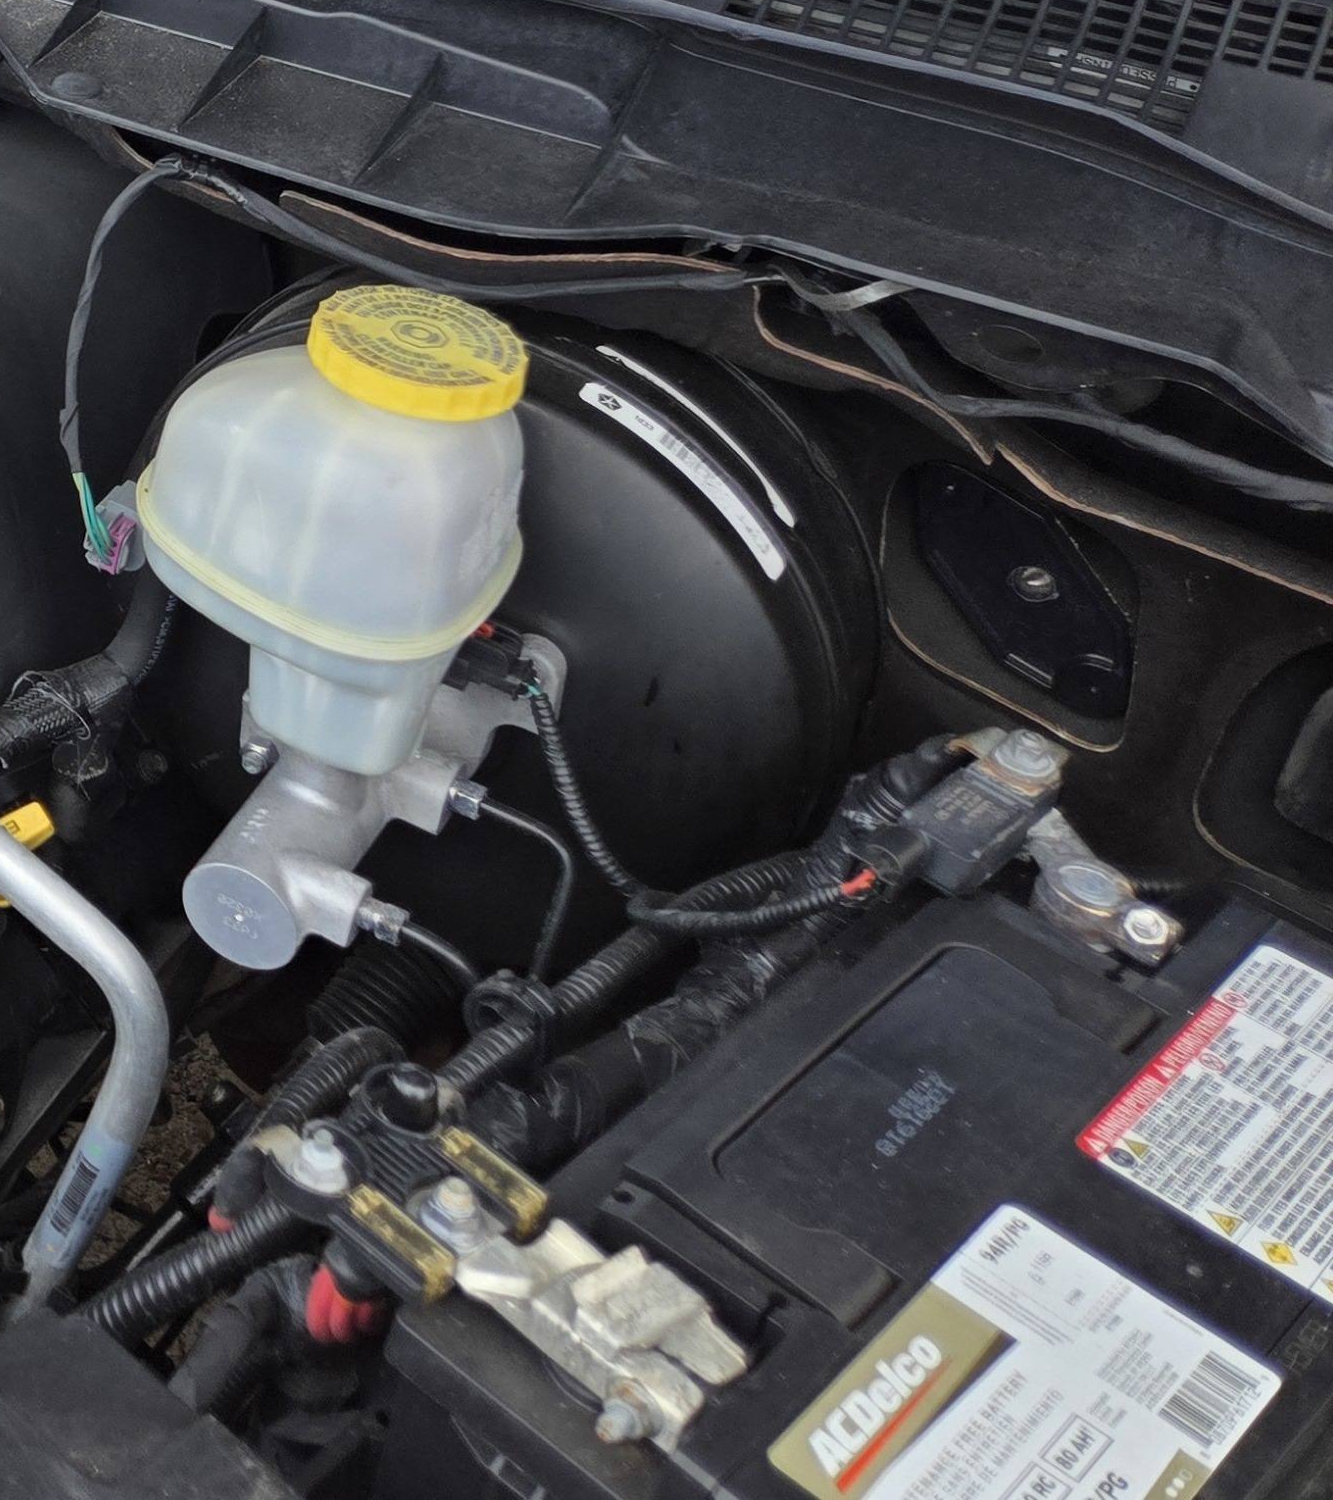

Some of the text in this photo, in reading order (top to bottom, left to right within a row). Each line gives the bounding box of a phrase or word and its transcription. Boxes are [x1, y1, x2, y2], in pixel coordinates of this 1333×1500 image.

[1091, 999, 1235, 1145] DANGER/POISON PELIGRO/VENENO
[978, 1216, 1032, 1266] 94R/PG
[807, 1334, 942, 1479] ACDelco
[949, 1417, 987, 1451] FREE
[976, 1369, 1030, 1421] BATTERY
[962, 1412, 1018, 1468] ENTRETIEN
[986, 1386, 1067, 1468] MANTENIMIENTO
[1030, 1474, 1056, 1497] RC
[1054, 1448, 1080, 1470] 80
